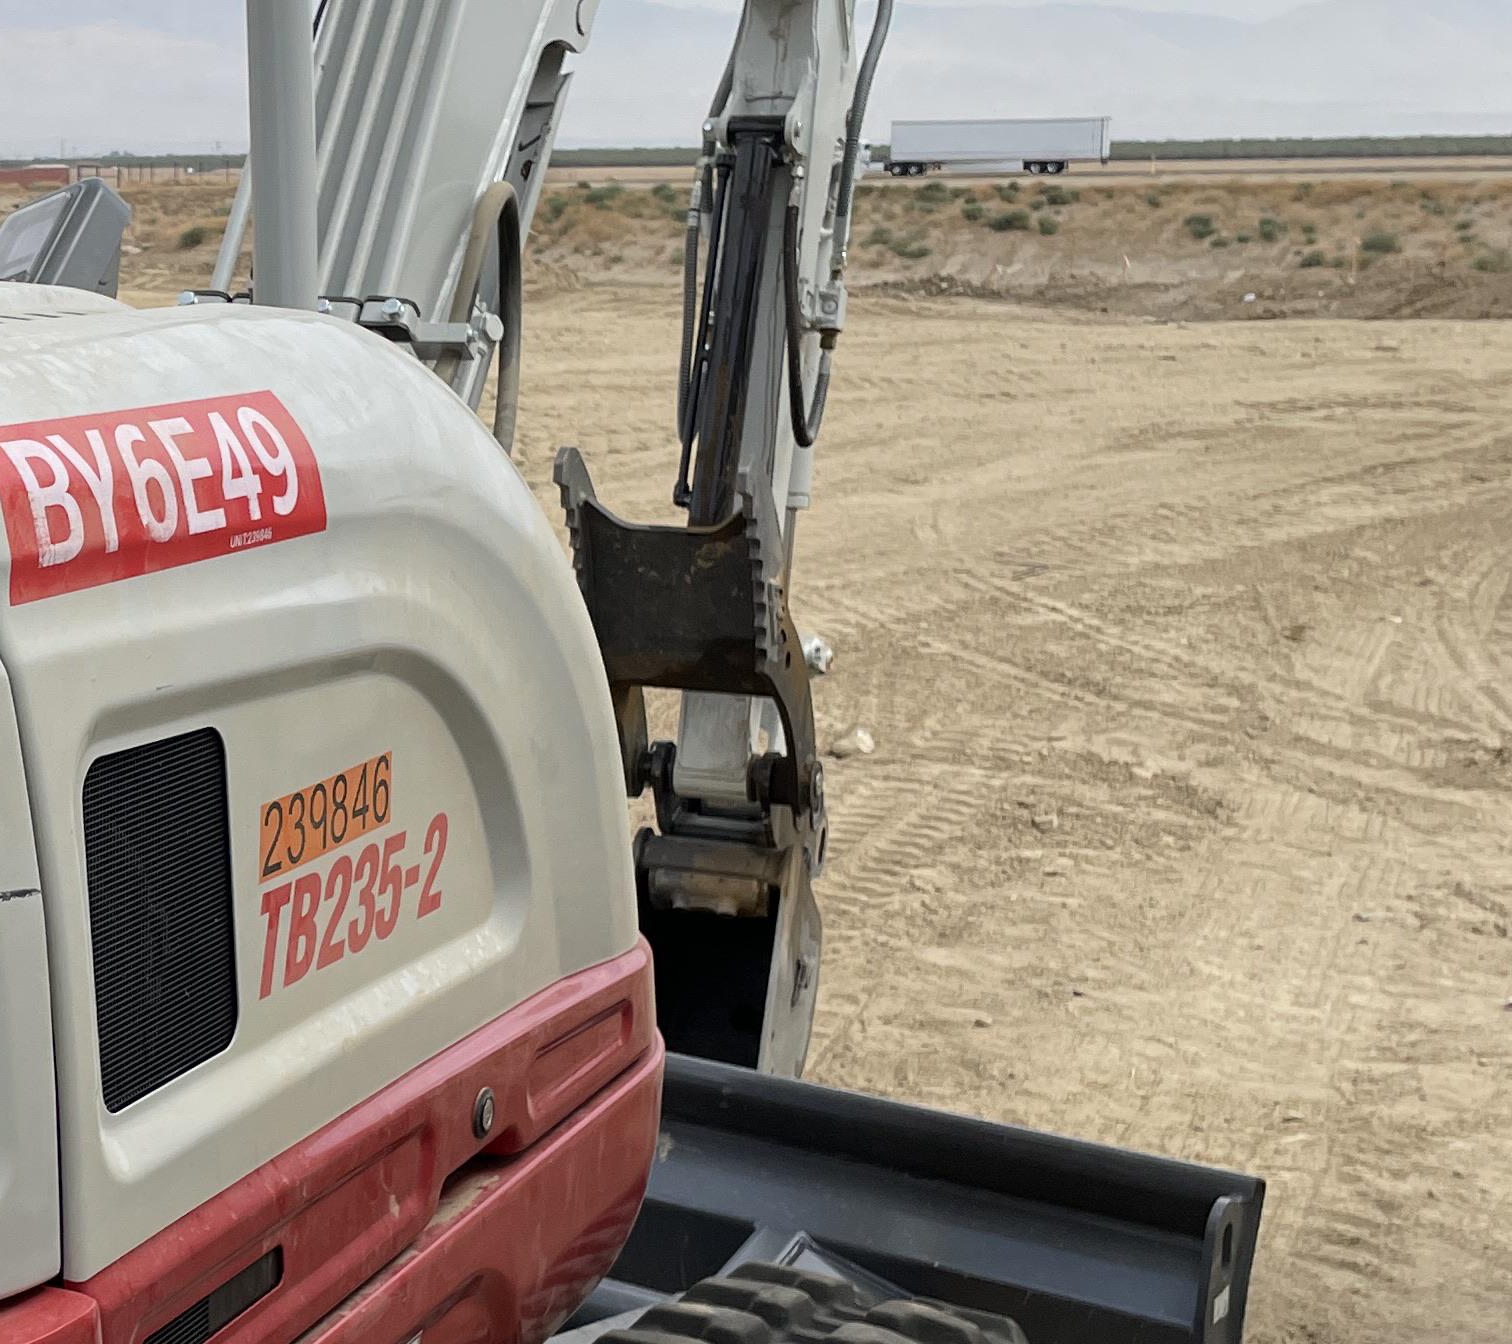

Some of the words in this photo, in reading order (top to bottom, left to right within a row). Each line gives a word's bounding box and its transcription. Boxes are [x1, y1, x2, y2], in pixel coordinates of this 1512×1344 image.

[0, 406, 299, 569] BY6E49
[262, 754, 390, 877] 239846
[259, 812, 449, 1001] TB235-2
